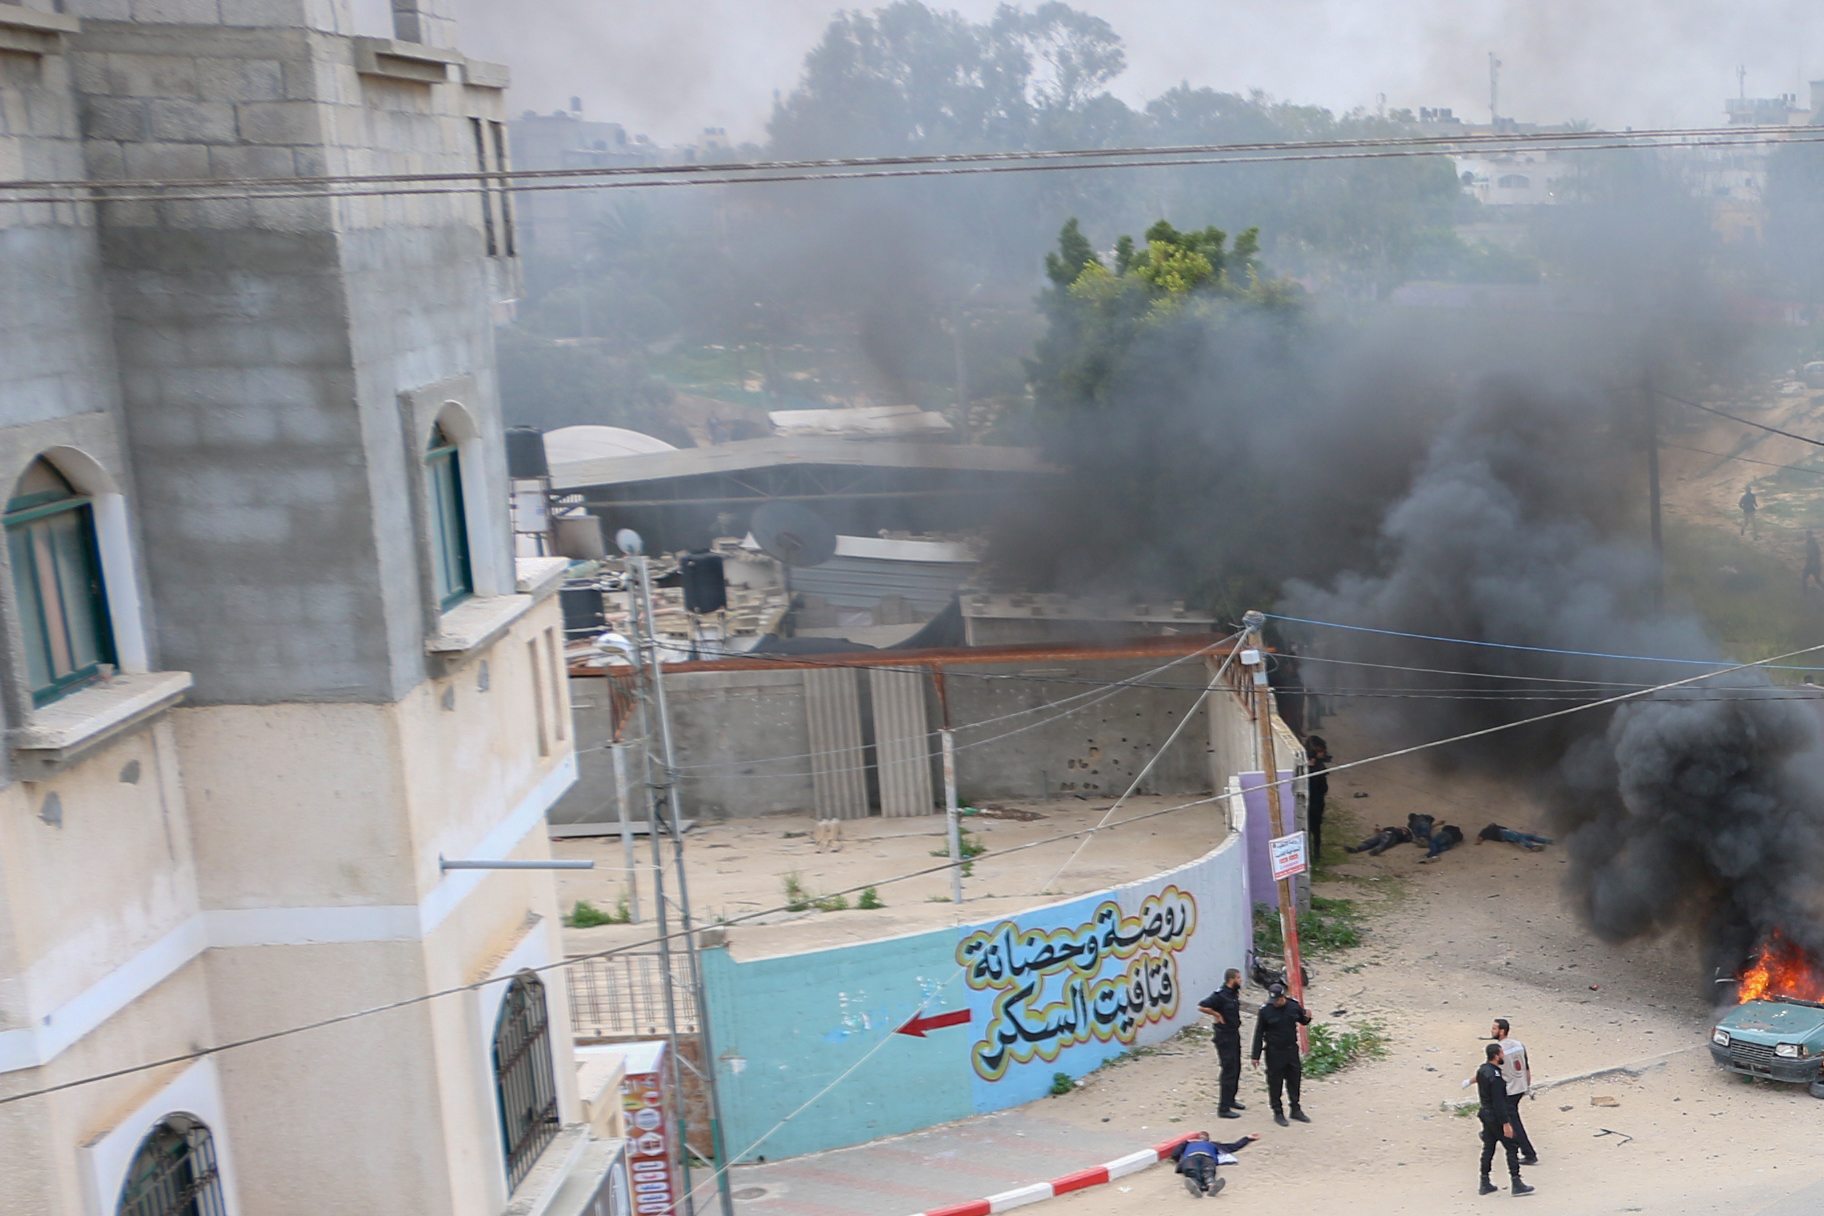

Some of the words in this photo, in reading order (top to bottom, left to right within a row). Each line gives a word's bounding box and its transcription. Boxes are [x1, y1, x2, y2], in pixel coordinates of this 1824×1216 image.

[963, 922, 1099, 981] وحضانة
[1100, 901, 1186, 948] روضة
[978, 979, 1089, 1070] السكر
[1093, 956, 1173, 1030] فتافيت
